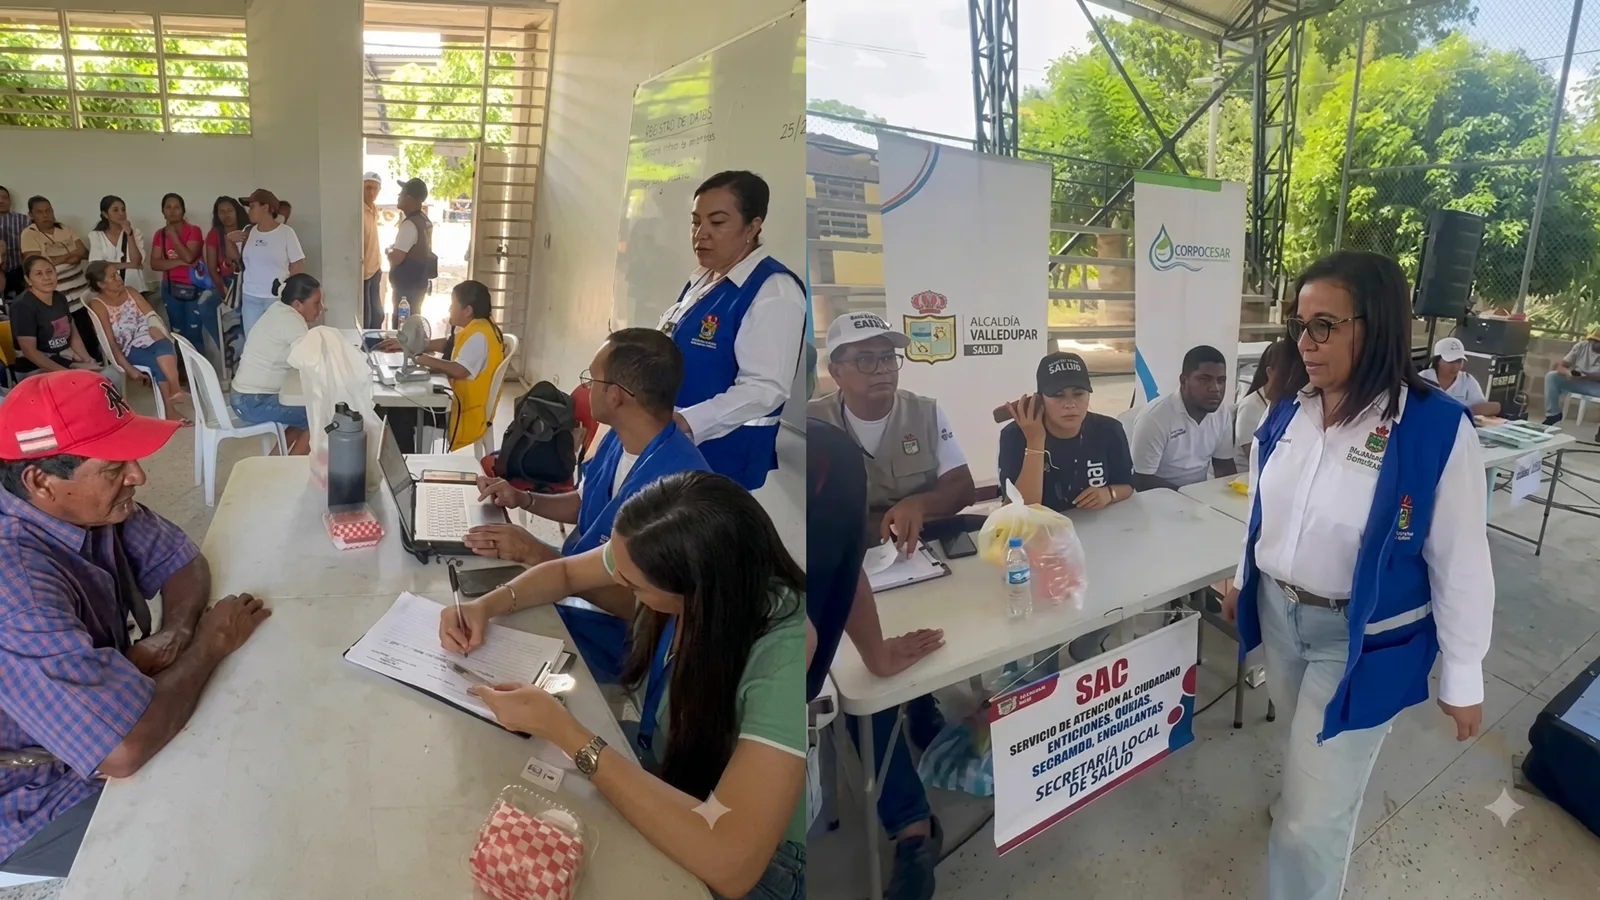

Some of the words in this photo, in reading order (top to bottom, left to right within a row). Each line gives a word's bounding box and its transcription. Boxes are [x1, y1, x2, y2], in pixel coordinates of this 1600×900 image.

[1174, 244, 1231, 259] CORPOCESAR
[970, 315, 1021, 327] ALCALDÍA
[970, 328, 1038, 341] VALLEDUPAR
[972, 345, 999, 355] SALUD
[1075, 657, 1129, 706] SAC
[1009, 726, 1057, 756] SERVICIO
[1059, 718, 1072, 733] DE
[1122, 690, 1134, 703] AL
[1134, 666, 1181, 696] CIUDADANO
[1097, 701, 1165, 744] ENGUALANTAS
[1035, 745, 1118, 801] SECRETARÍA
[1121, 723, 1161, 754] LOCAL
[1069, 777, 1088, 798] DE
[1090, 751, 1134, 786] SALUD
